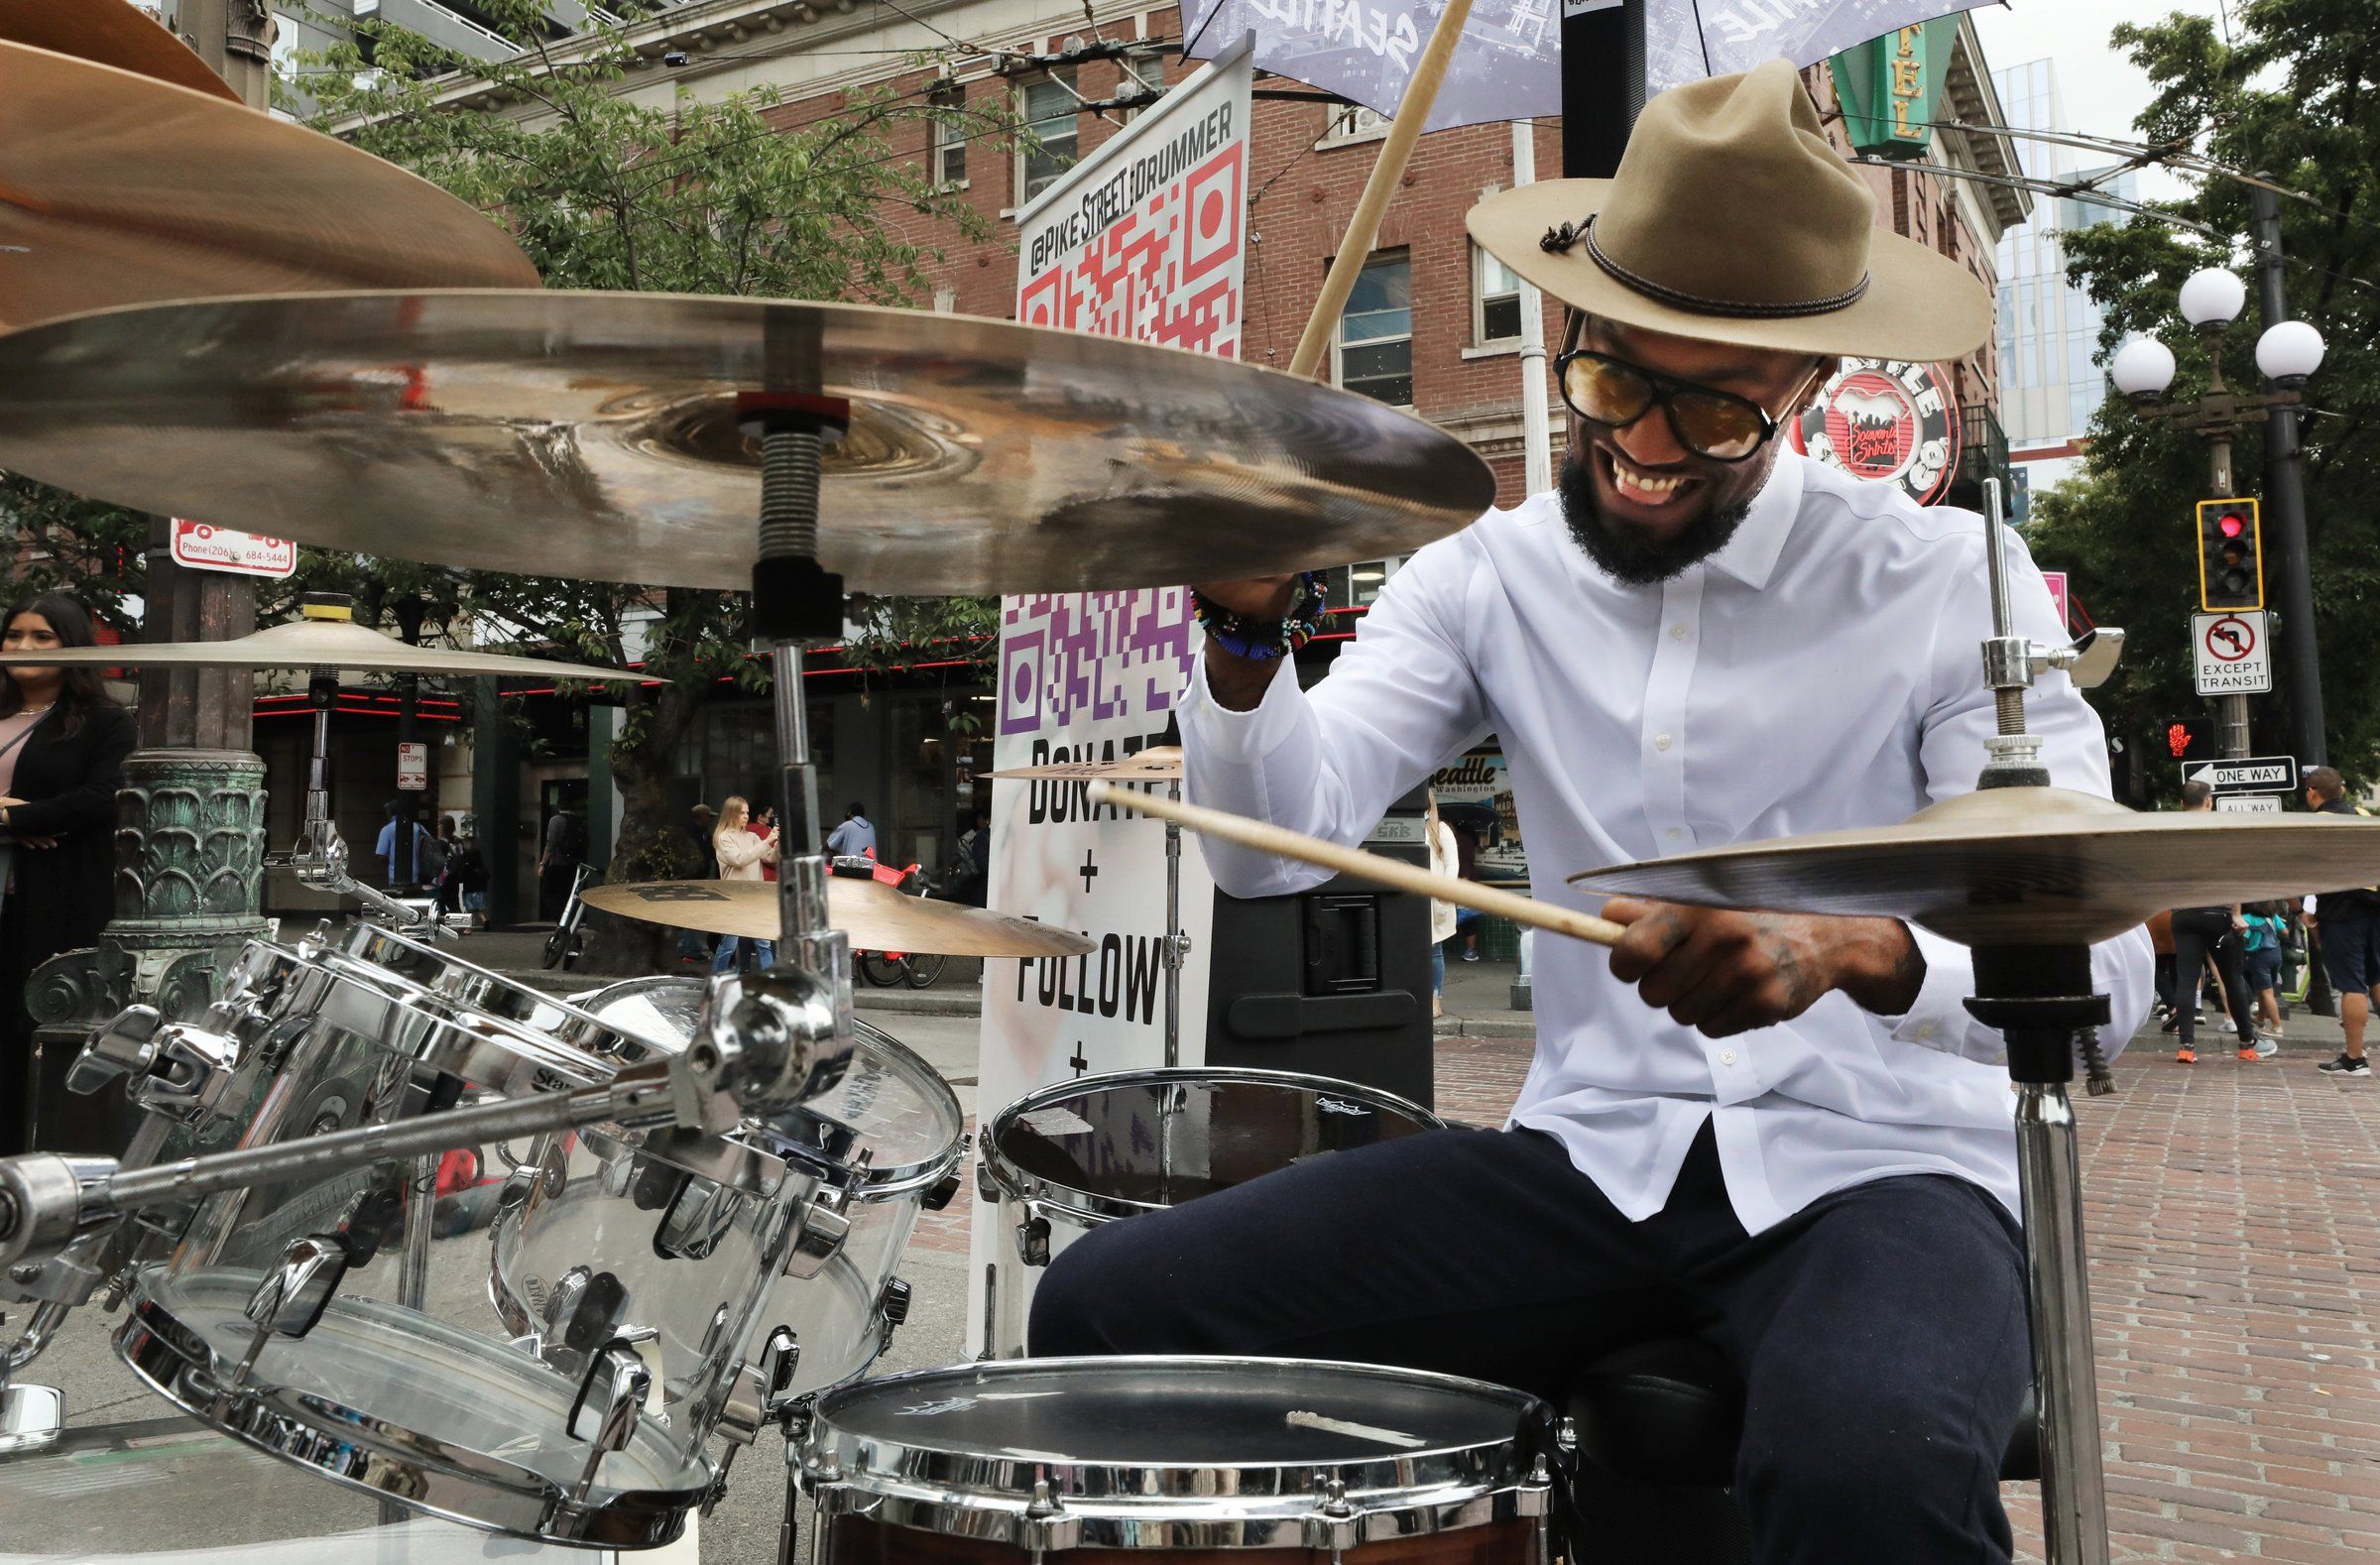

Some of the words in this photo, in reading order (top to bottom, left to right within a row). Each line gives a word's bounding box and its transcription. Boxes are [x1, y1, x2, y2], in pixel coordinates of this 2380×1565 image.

[1030, 211, 1080, 277] @PIKE
[1081, 167, 1129, 241] STREET
[1134, 100, 1233, 203] DRUMMER
[182, 542, 207, 554] Phone
[245, 550, 288, 563] 684-5444
[2202, 662, 2261, 674] EXCEPT
[2202, 674, 2266, 688] TRANSIT
[2216, 770, 2246, 782] ONE
[2250, 767, 2282, 782] WAY
[1435, 784, 1495, 795] Washington
